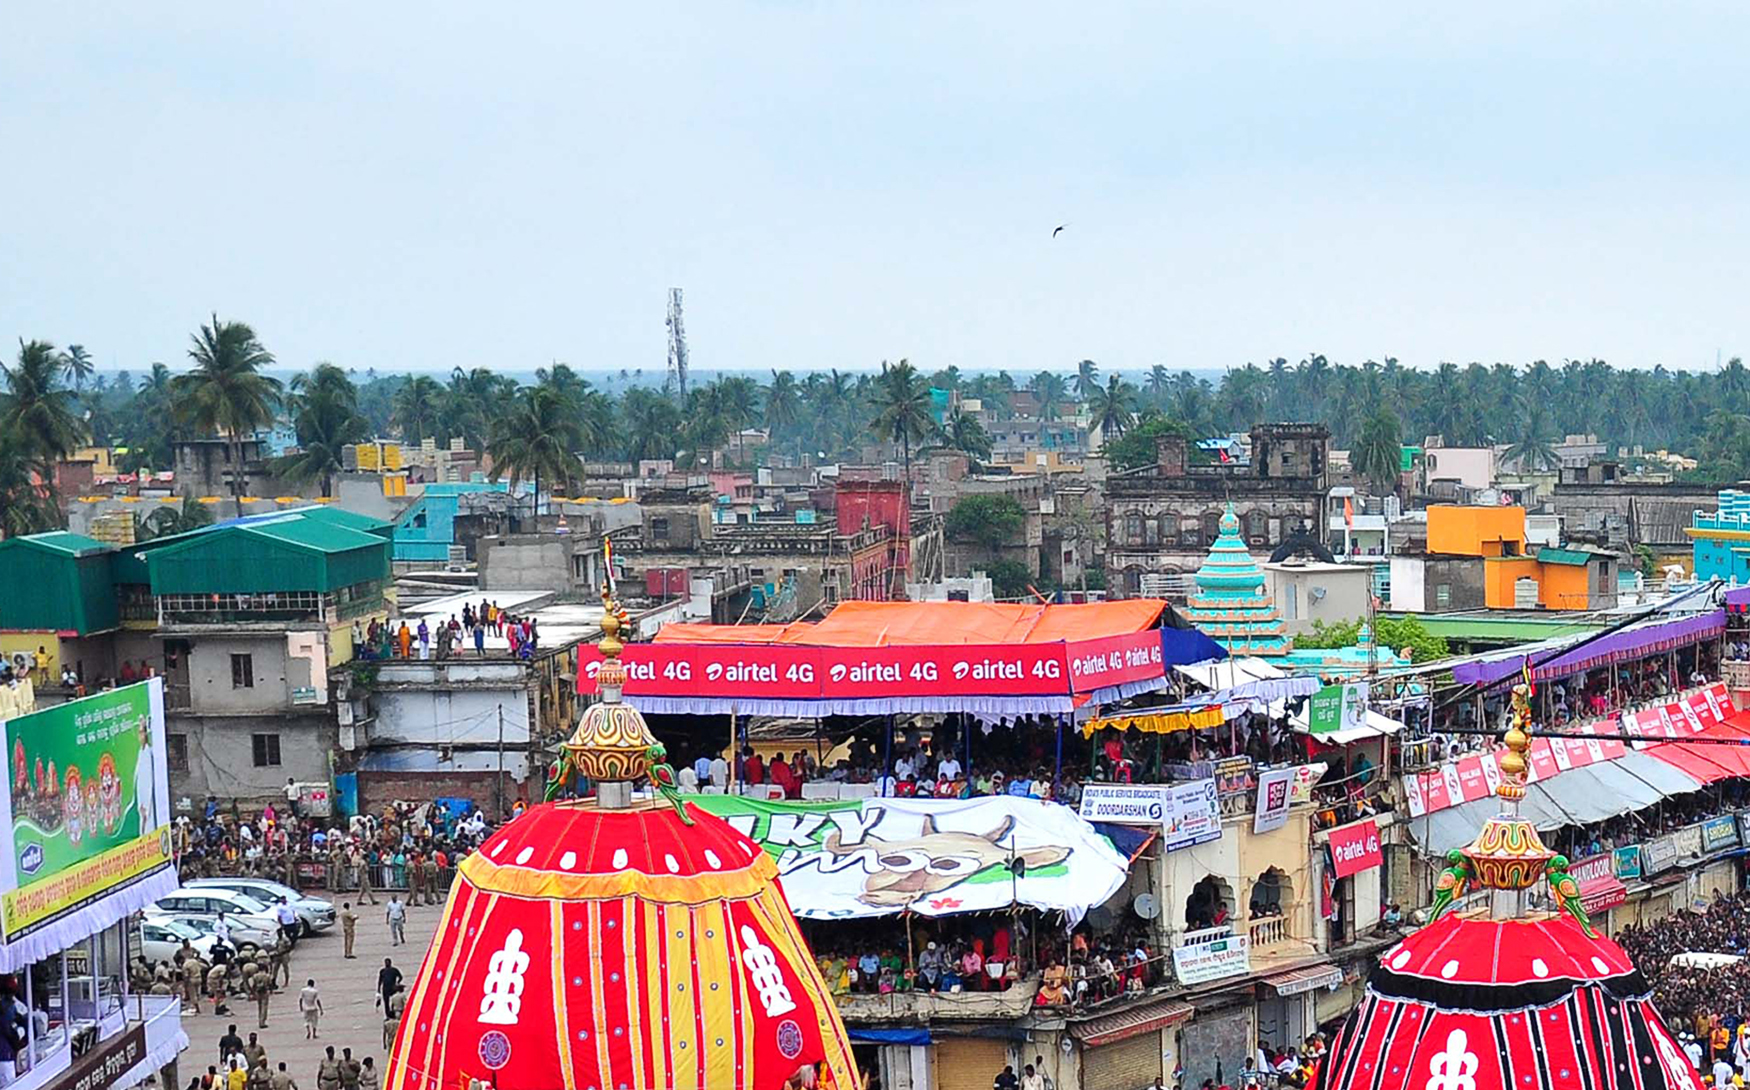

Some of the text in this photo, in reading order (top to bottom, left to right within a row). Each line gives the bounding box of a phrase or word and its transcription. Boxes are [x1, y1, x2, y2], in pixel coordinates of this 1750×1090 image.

[1082, 650, 1122, 675] airtel 4G
[1131, 645, 1161, 667] airtel 4G
[610, 659, 1060, 683] rtel 4G airtel 4G airtel 4G airtel 4G
[727, 806, 887, 848] LKY
[1343, 835, 1378, 861] airtel 4G
